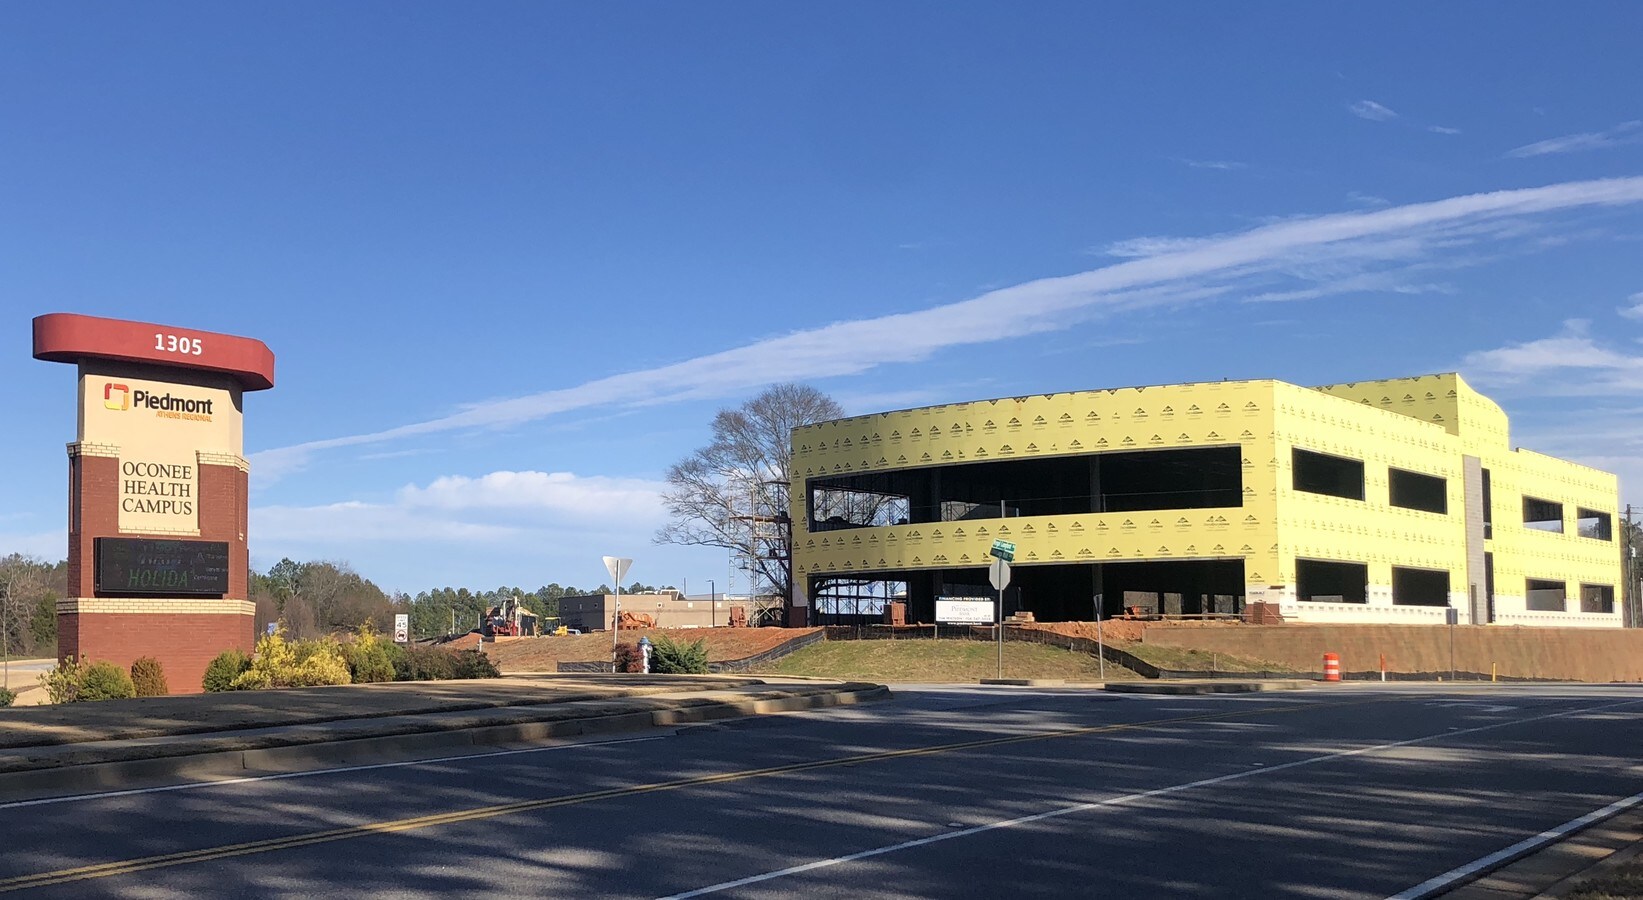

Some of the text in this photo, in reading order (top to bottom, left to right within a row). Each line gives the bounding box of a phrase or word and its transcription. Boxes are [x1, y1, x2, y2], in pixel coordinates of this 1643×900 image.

[154, 333, 203, 356] 1305
[133, 390, 213, 415] Piedmont
[155, 410, 213, 423] ATHENS REGIONAL
[122, 461, 192, 480] OCONEE
[123, 480, 191, 498] HEALTH
[122, 498, 193, 516] CAMPUS
